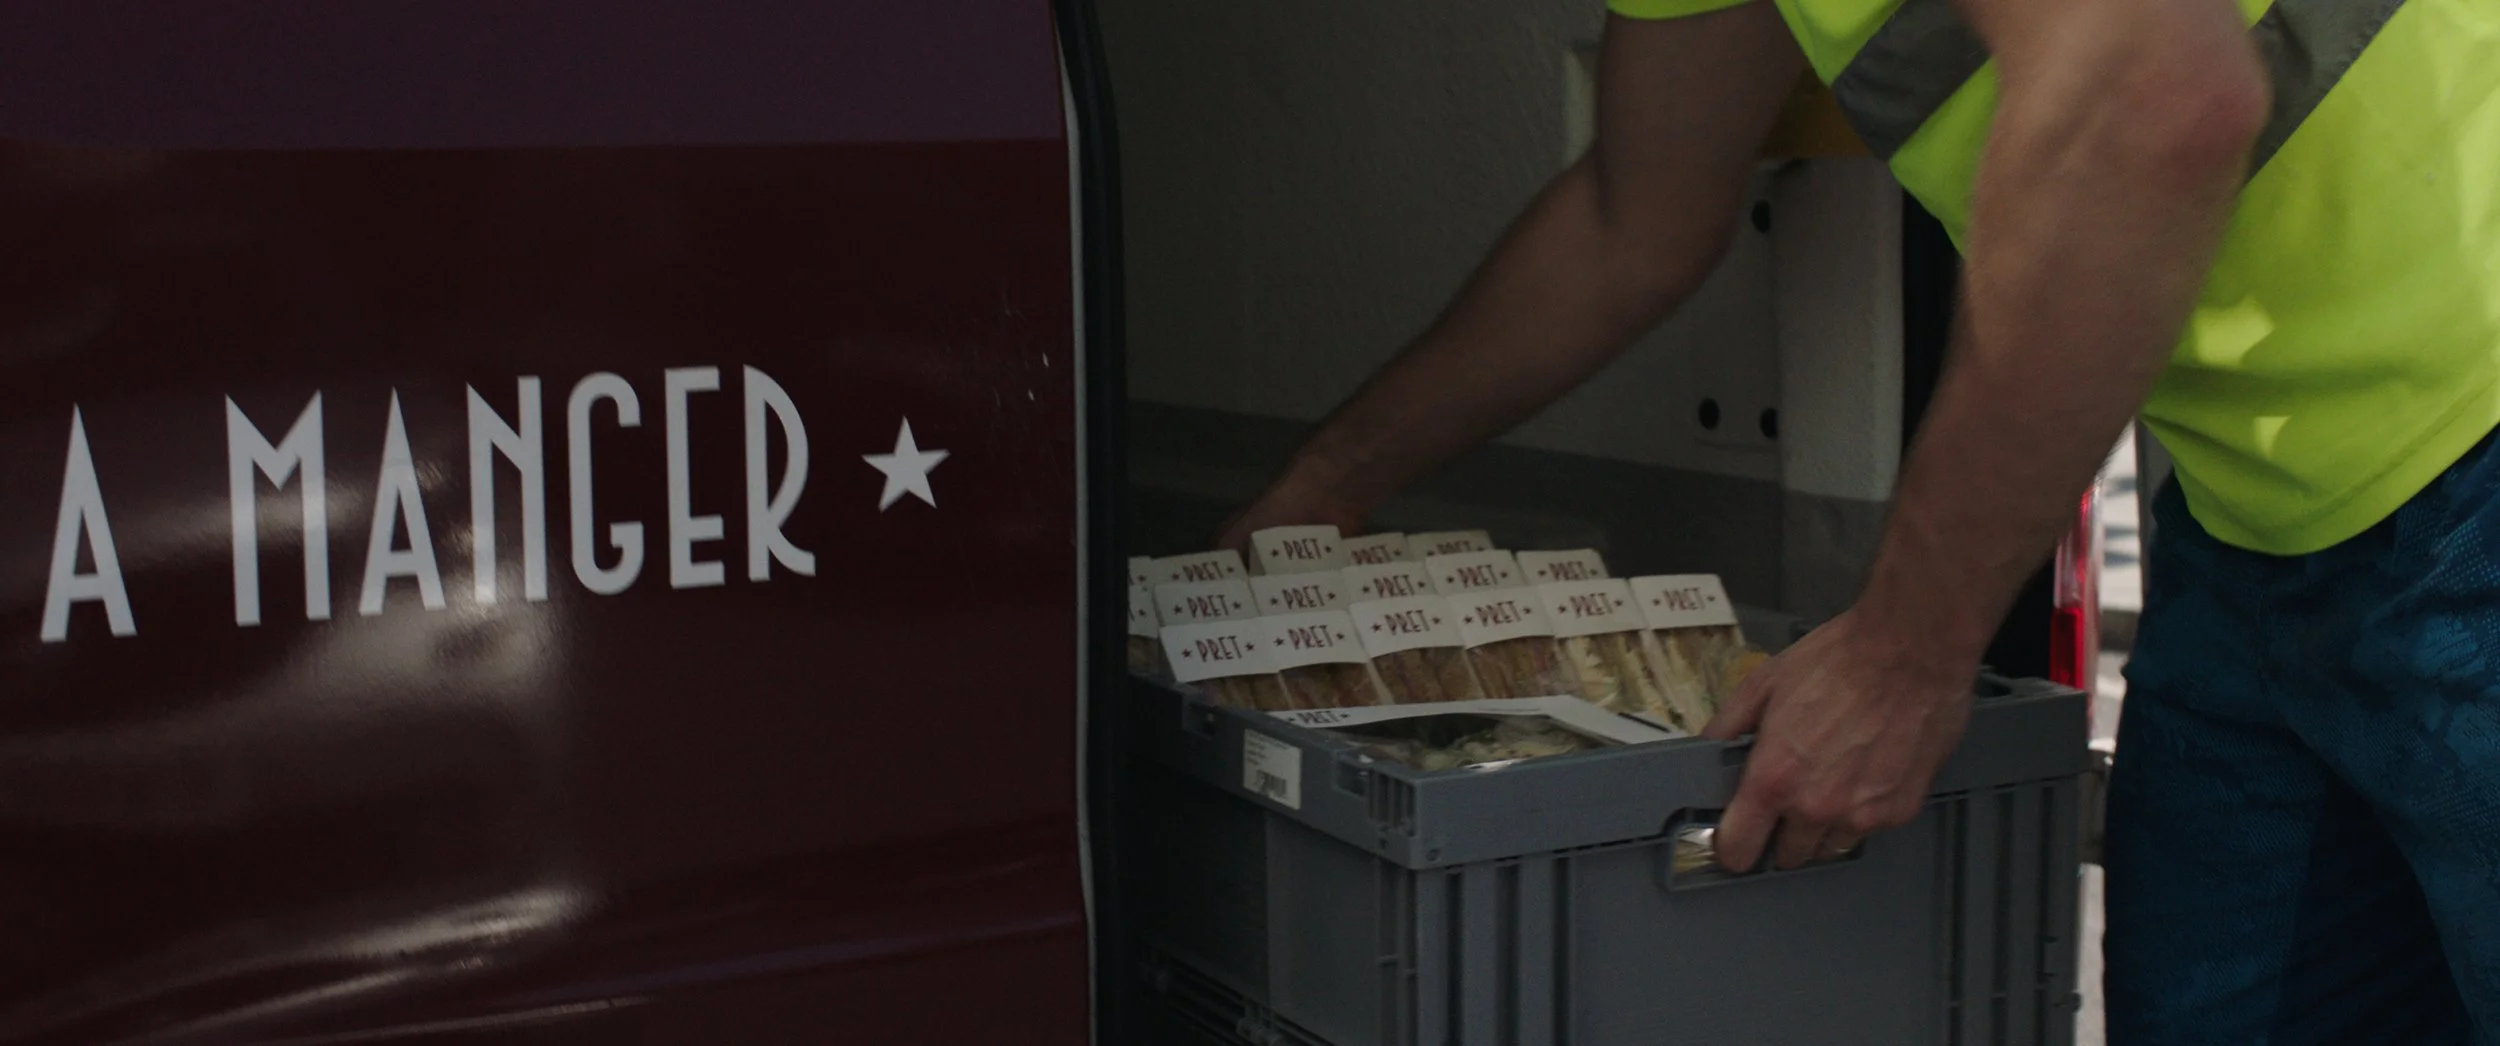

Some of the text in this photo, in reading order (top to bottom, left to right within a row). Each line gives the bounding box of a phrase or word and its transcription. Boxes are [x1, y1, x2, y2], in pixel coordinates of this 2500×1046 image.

[40, 364, 816, 643] A MANGER
[1282, 538, 1322, 560] PRET
[1351, 544, 1391, 565] PRET
[1183, 561, 1224, 582] PRET
[1457, 564, 1499, 588] PRET
[1548, 561, 1589, 581] PRET
[1282, 585, 1326, 610] PRET
[1373, 574, 1415, 597] PRET
[1187, 594, 1230, 618] PRET
[1569, 592, 1614, 618] PRET
[1663, 587, 1706, 611] PRET
[1384, 609, 1431, 635] PRET
[1475, 601, 1522, 627] PRET
[1195, 635, 1243, 662] PRET
[1288, 625, 1334, 650] PRET
[1297, 710, 1342, 725] PRET
